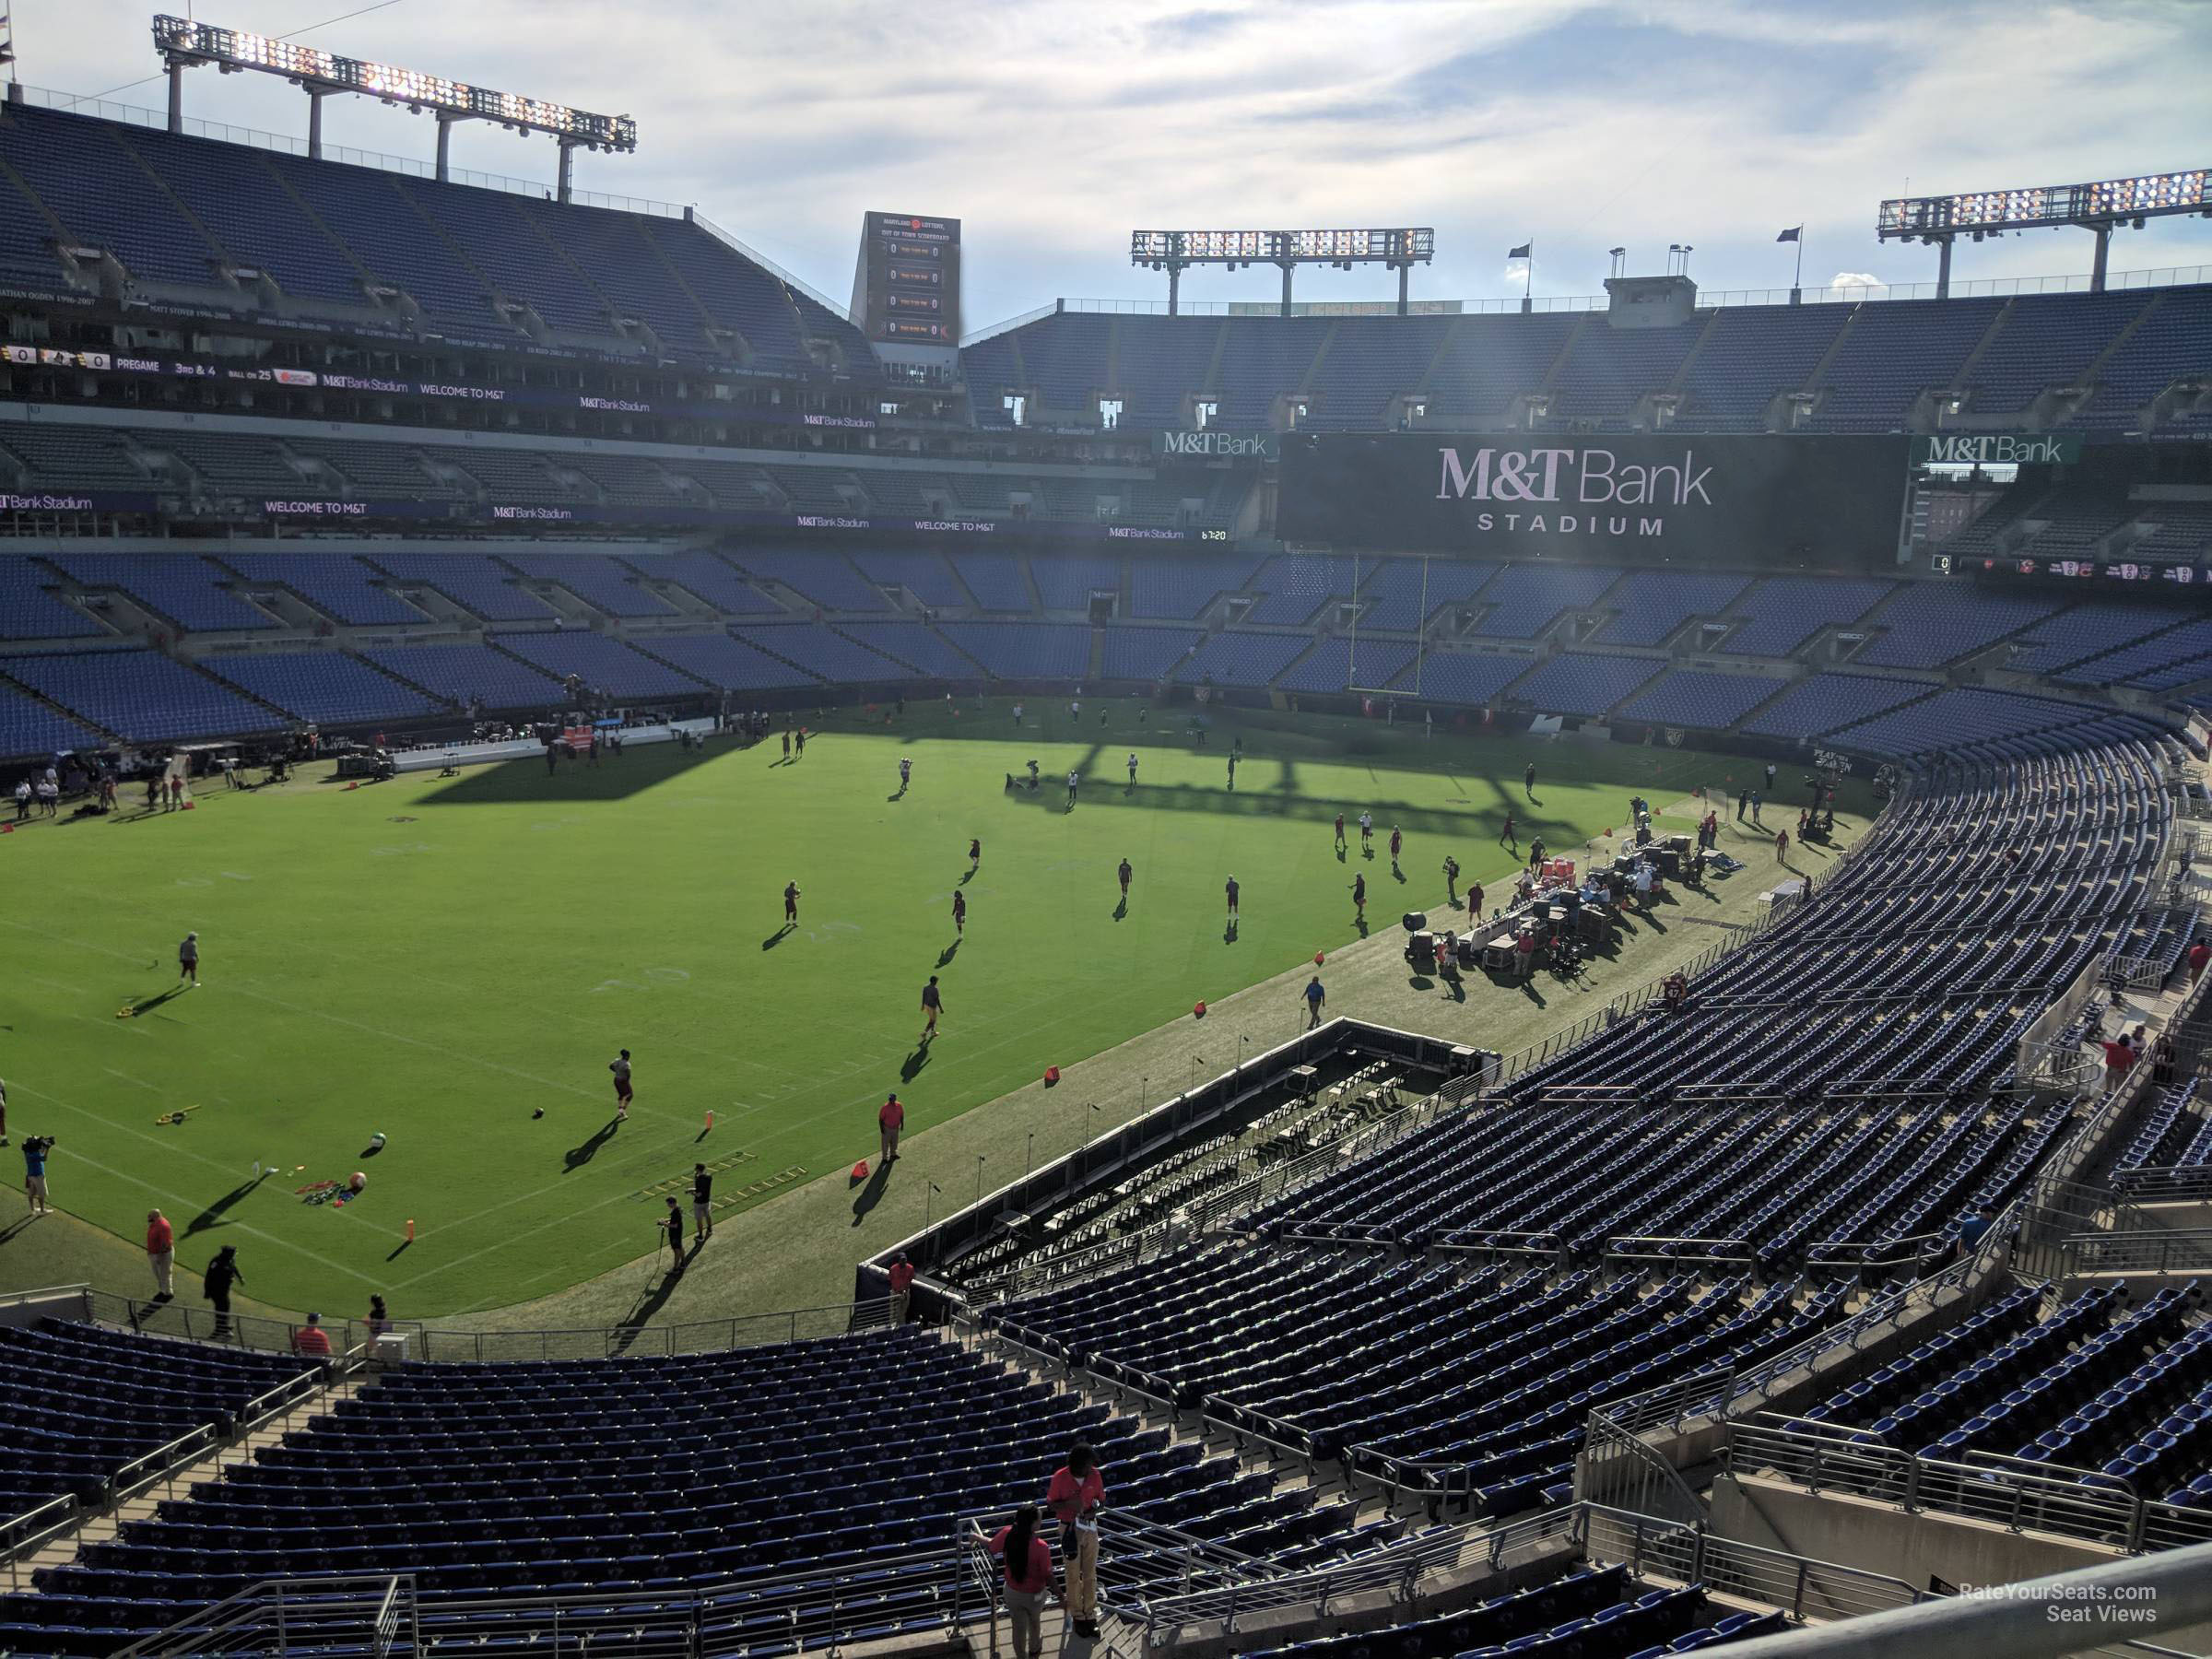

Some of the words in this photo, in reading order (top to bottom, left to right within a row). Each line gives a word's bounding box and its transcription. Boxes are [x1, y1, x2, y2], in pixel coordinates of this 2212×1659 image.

[890, 243, 897, 253] 0
[933, 247, 938, 256] 0
[890, 270, 897, 279] 0
[933, 274, 938, 283] 0
[29, 291, 54, 302] OGDEN
[890, 296, 896, 305] 0
[932, 300, 937, 309] 0
[889, 323, 896, 332] 0
[932, 325, 937, 335] 0
[18, 349, 28, 361] 0
[94, 356, 103, 367] 0
[117, 359, 159, 371] PREGAME
[175, 363, 194, 374] 3RD
[196, 365, 206, 375] &
[208, 366, 217, 376] 4
[229, 371, 244, 379] BALL
[259, 371, 271, 380] 25
[323, 374, 347, 388] M&T
[347, 377, 370, 389] Bank
[371, 379, 408, 394] Stadium
[420, 383, 468, 397] WELCOME
[470, 388, 484, 398] TO
[485, 390, 505, 400] M&T
[580, 397, 600, 408] M&T
[600, 400, 618, 410] Bank
[619, 401, 650, 413] Stadium
[804, 414, 824, 425] M&T
[825, 417, 843, 427] Bank
[843, 418, 875, 429] Stadium
[1164, 431, 1215, 453] M&T
[1218, 433, 1266, 454] Bank
[1927, 436, 1996, 462] M&T
[1997, 437, 2062, 463] Bank
[1436, 448, 1574, 500] M&T
[1580, 450, 1713, 505] Bank
[11, 495, 42, 509] Bank
[43, 495, 92, 510] Stadium
[265, 501, 323, 513] WELCOME
[325, 503, 341, 513] TO
[344, 503, 367, 514] M&T
[494, 507, 516, 518] M&T
[517, 508, 537, 518] Bank
[538, 508, 571, 519] Stadium
[797, 516, 818, 526] M&T
[818, 517, 836, 526] Bank
[837, 518, 869, 528] Stadium
[915, 522, 959, 531] WELCOME
[962, 523, 974, 531] TO
[976, 524, 995, 532] M&T
[1477, 513, 1662, 536] STADIUM
[1110, 527, 1130, 537] M&T
[1131, 528, 1149, 537] Bank
[1150, 529, 1183, 539] Stadium
